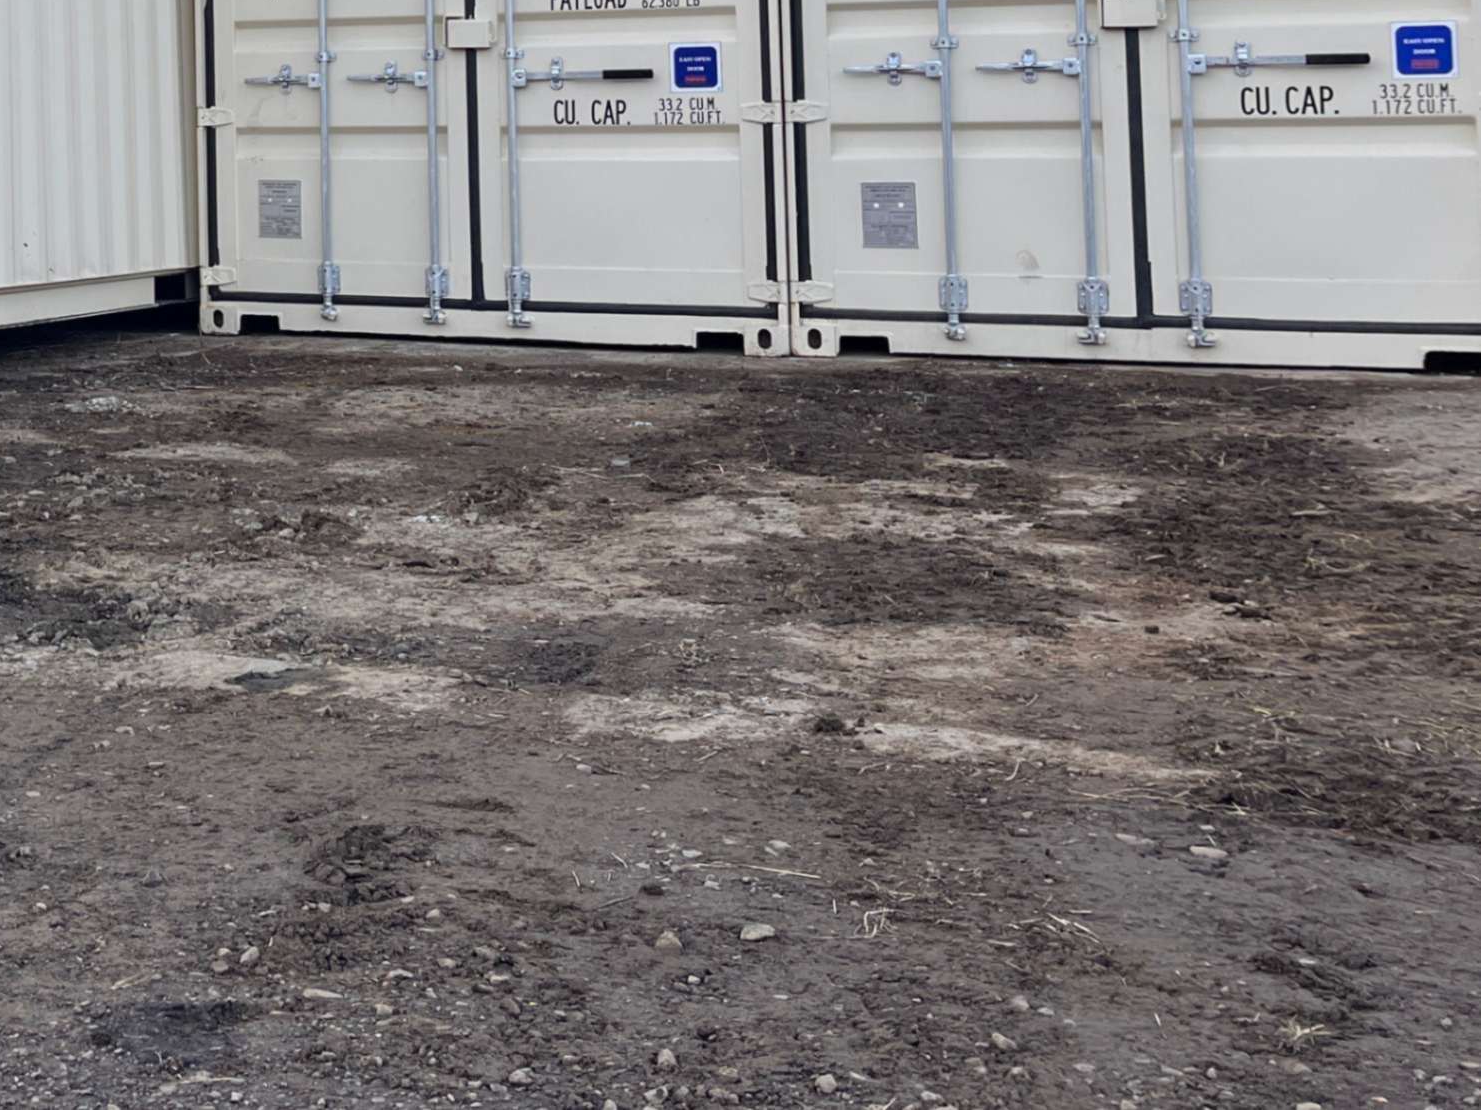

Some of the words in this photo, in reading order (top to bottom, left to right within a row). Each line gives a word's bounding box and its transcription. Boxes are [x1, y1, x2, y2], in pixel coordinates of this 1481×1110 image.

[553, 99, 580, 125] CU.
[591, 99, 631, 126] CAP.
[1240, 86, 1277, 115] CU.
[1285, 85, 1340, 115] CAP.
